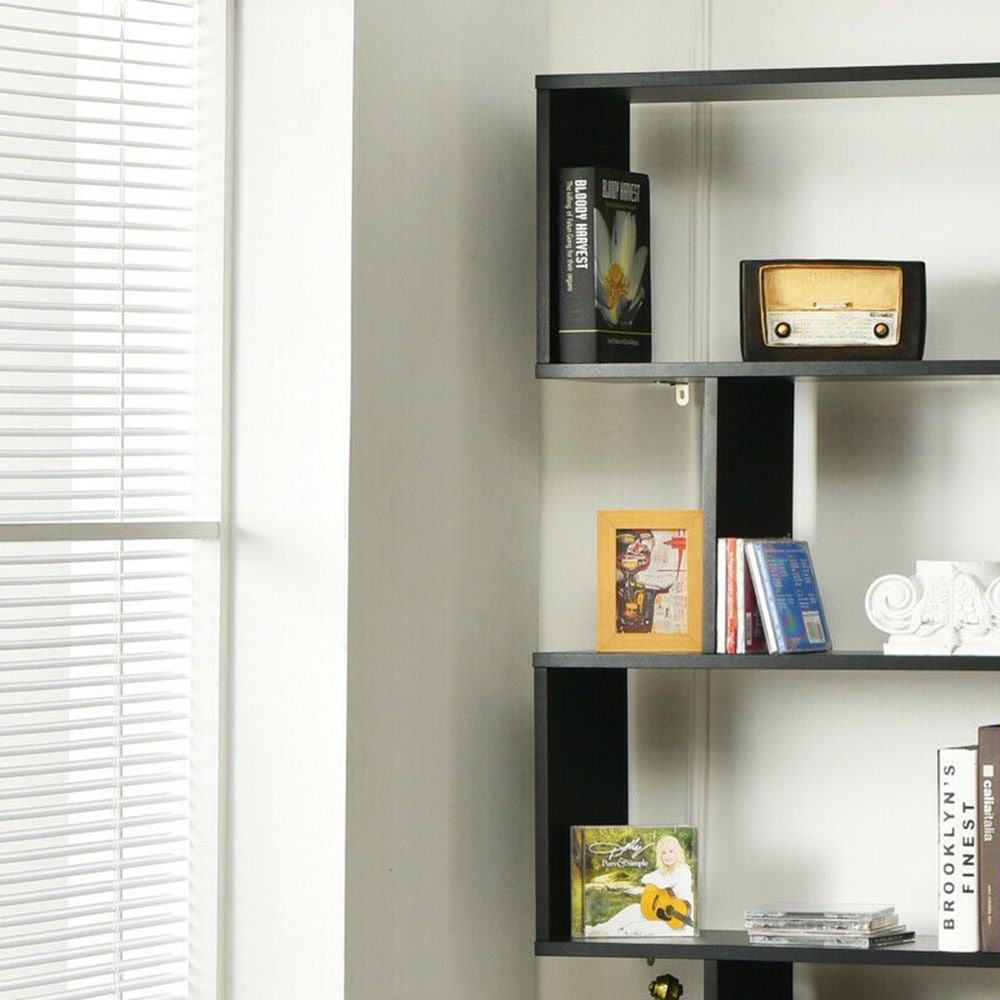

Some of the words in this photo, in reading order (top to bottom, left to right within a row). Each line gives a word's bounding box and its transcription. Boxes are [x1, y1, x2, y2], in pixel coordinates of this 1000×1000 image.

[564, 192, 574, 209] killing
[575, 179, 587, 220] BLOODY
[564, 234, 573, 248] Gong
[566, 250, 574, 258] for
[576, 223, 588, 269] HARVEST
[566, 259, 574, 272] their
[564, 272, 573, 292] organs
[983, 780, 994, 842] caliaitalia
[943, 764, 956, 930] BROOKLYN'S
[962, 802, 975, 894] FINEST
